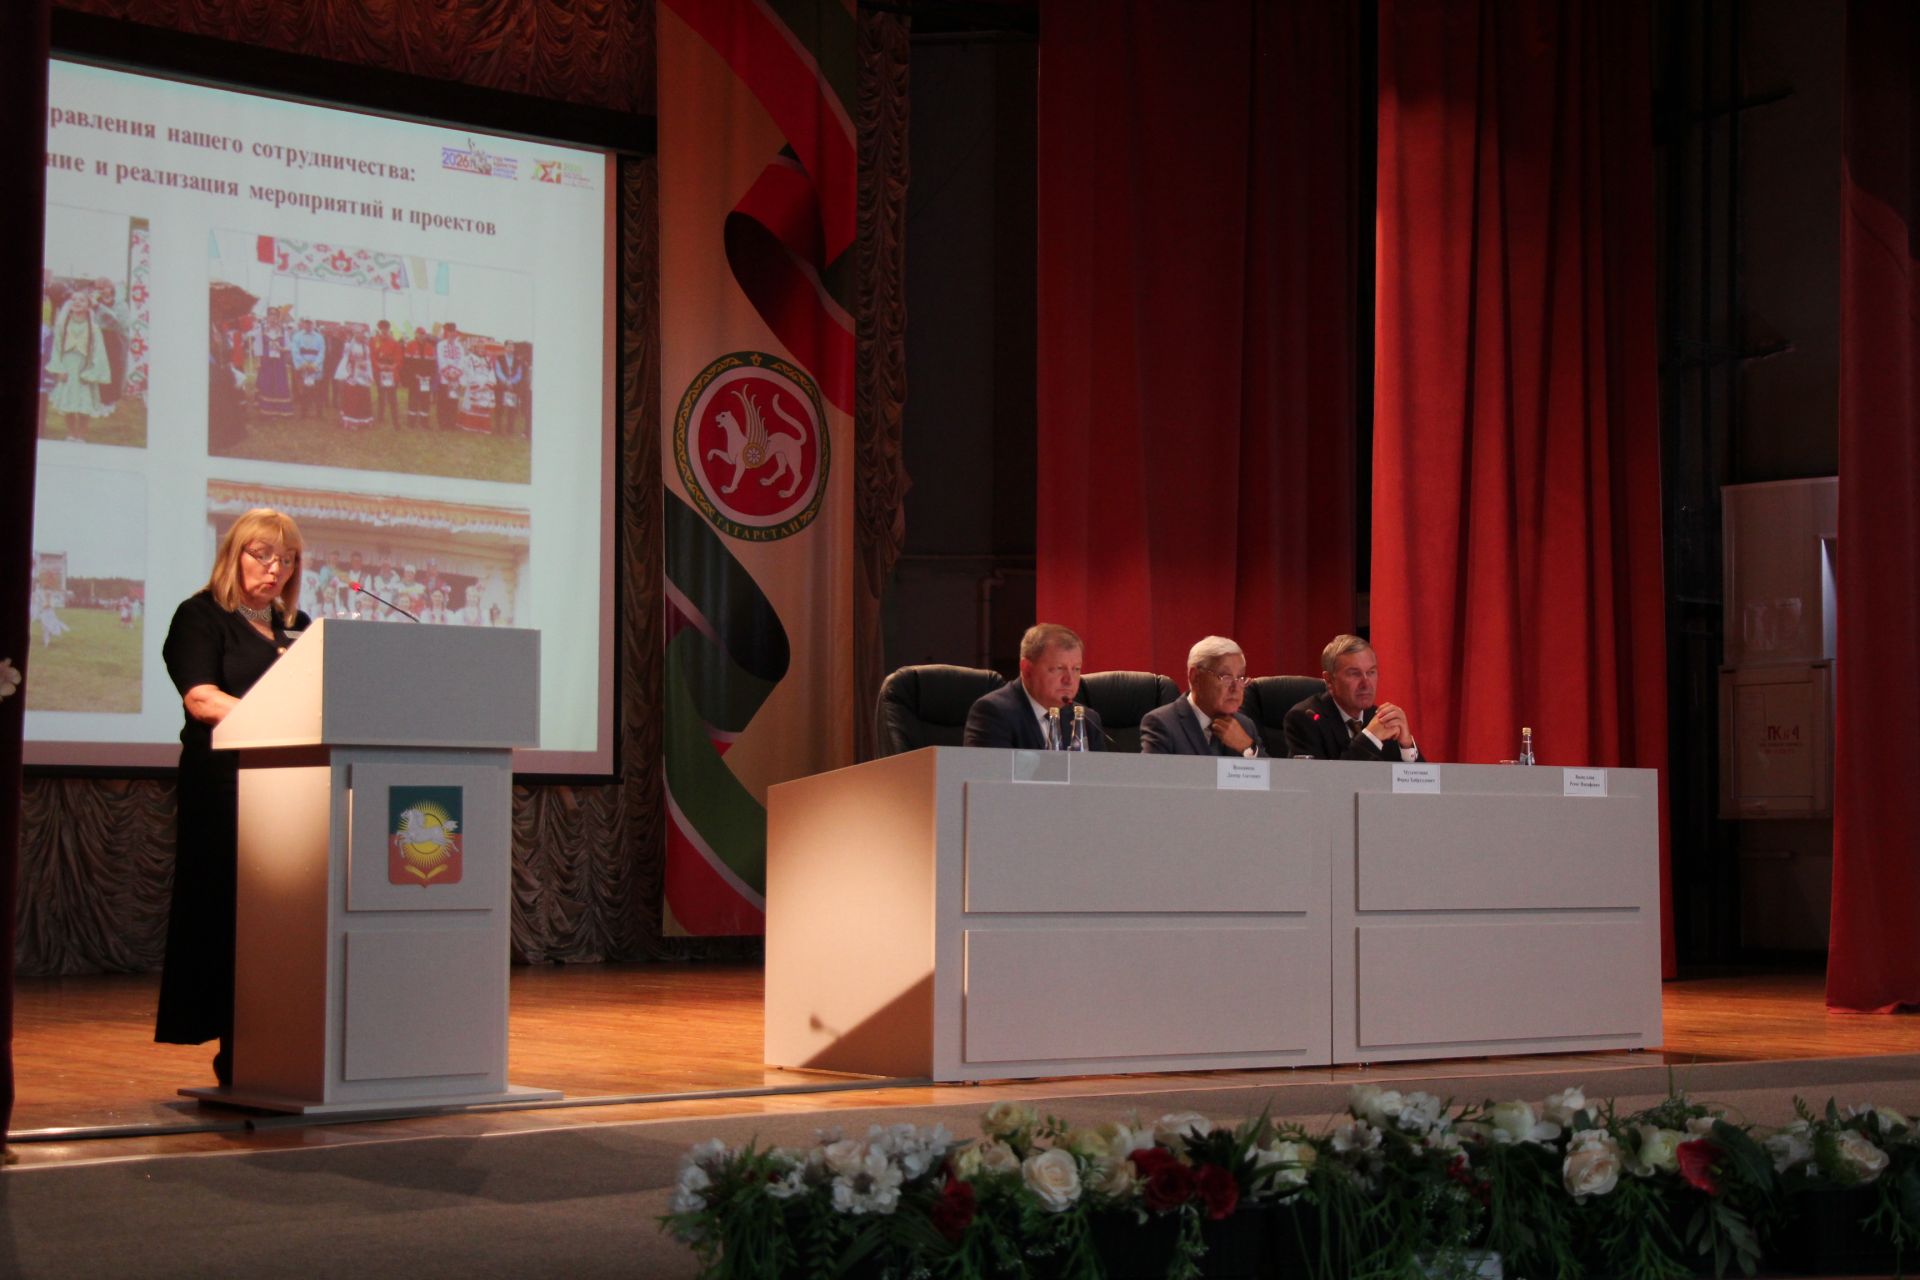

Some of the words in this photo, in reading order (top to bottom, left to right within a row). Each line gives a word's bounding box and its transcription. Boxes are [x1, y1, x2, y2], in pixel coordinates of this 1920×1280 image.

[50, 106, 155, 139] равления
[167, 127, 243, 154] нашего
[252, 142, 416, 182] сотрудничества:
[442, 152, 470, 168] 2026
[95, 160, 108, 177] и
[116, 162, 239, 197] реализация
[249, 184, 384, 219] мероприятий
[392, 207, 403, 222] и
[410, 210, 496, 236] проектов
[716, 517, 800, 540] ТАТАРСТАН
